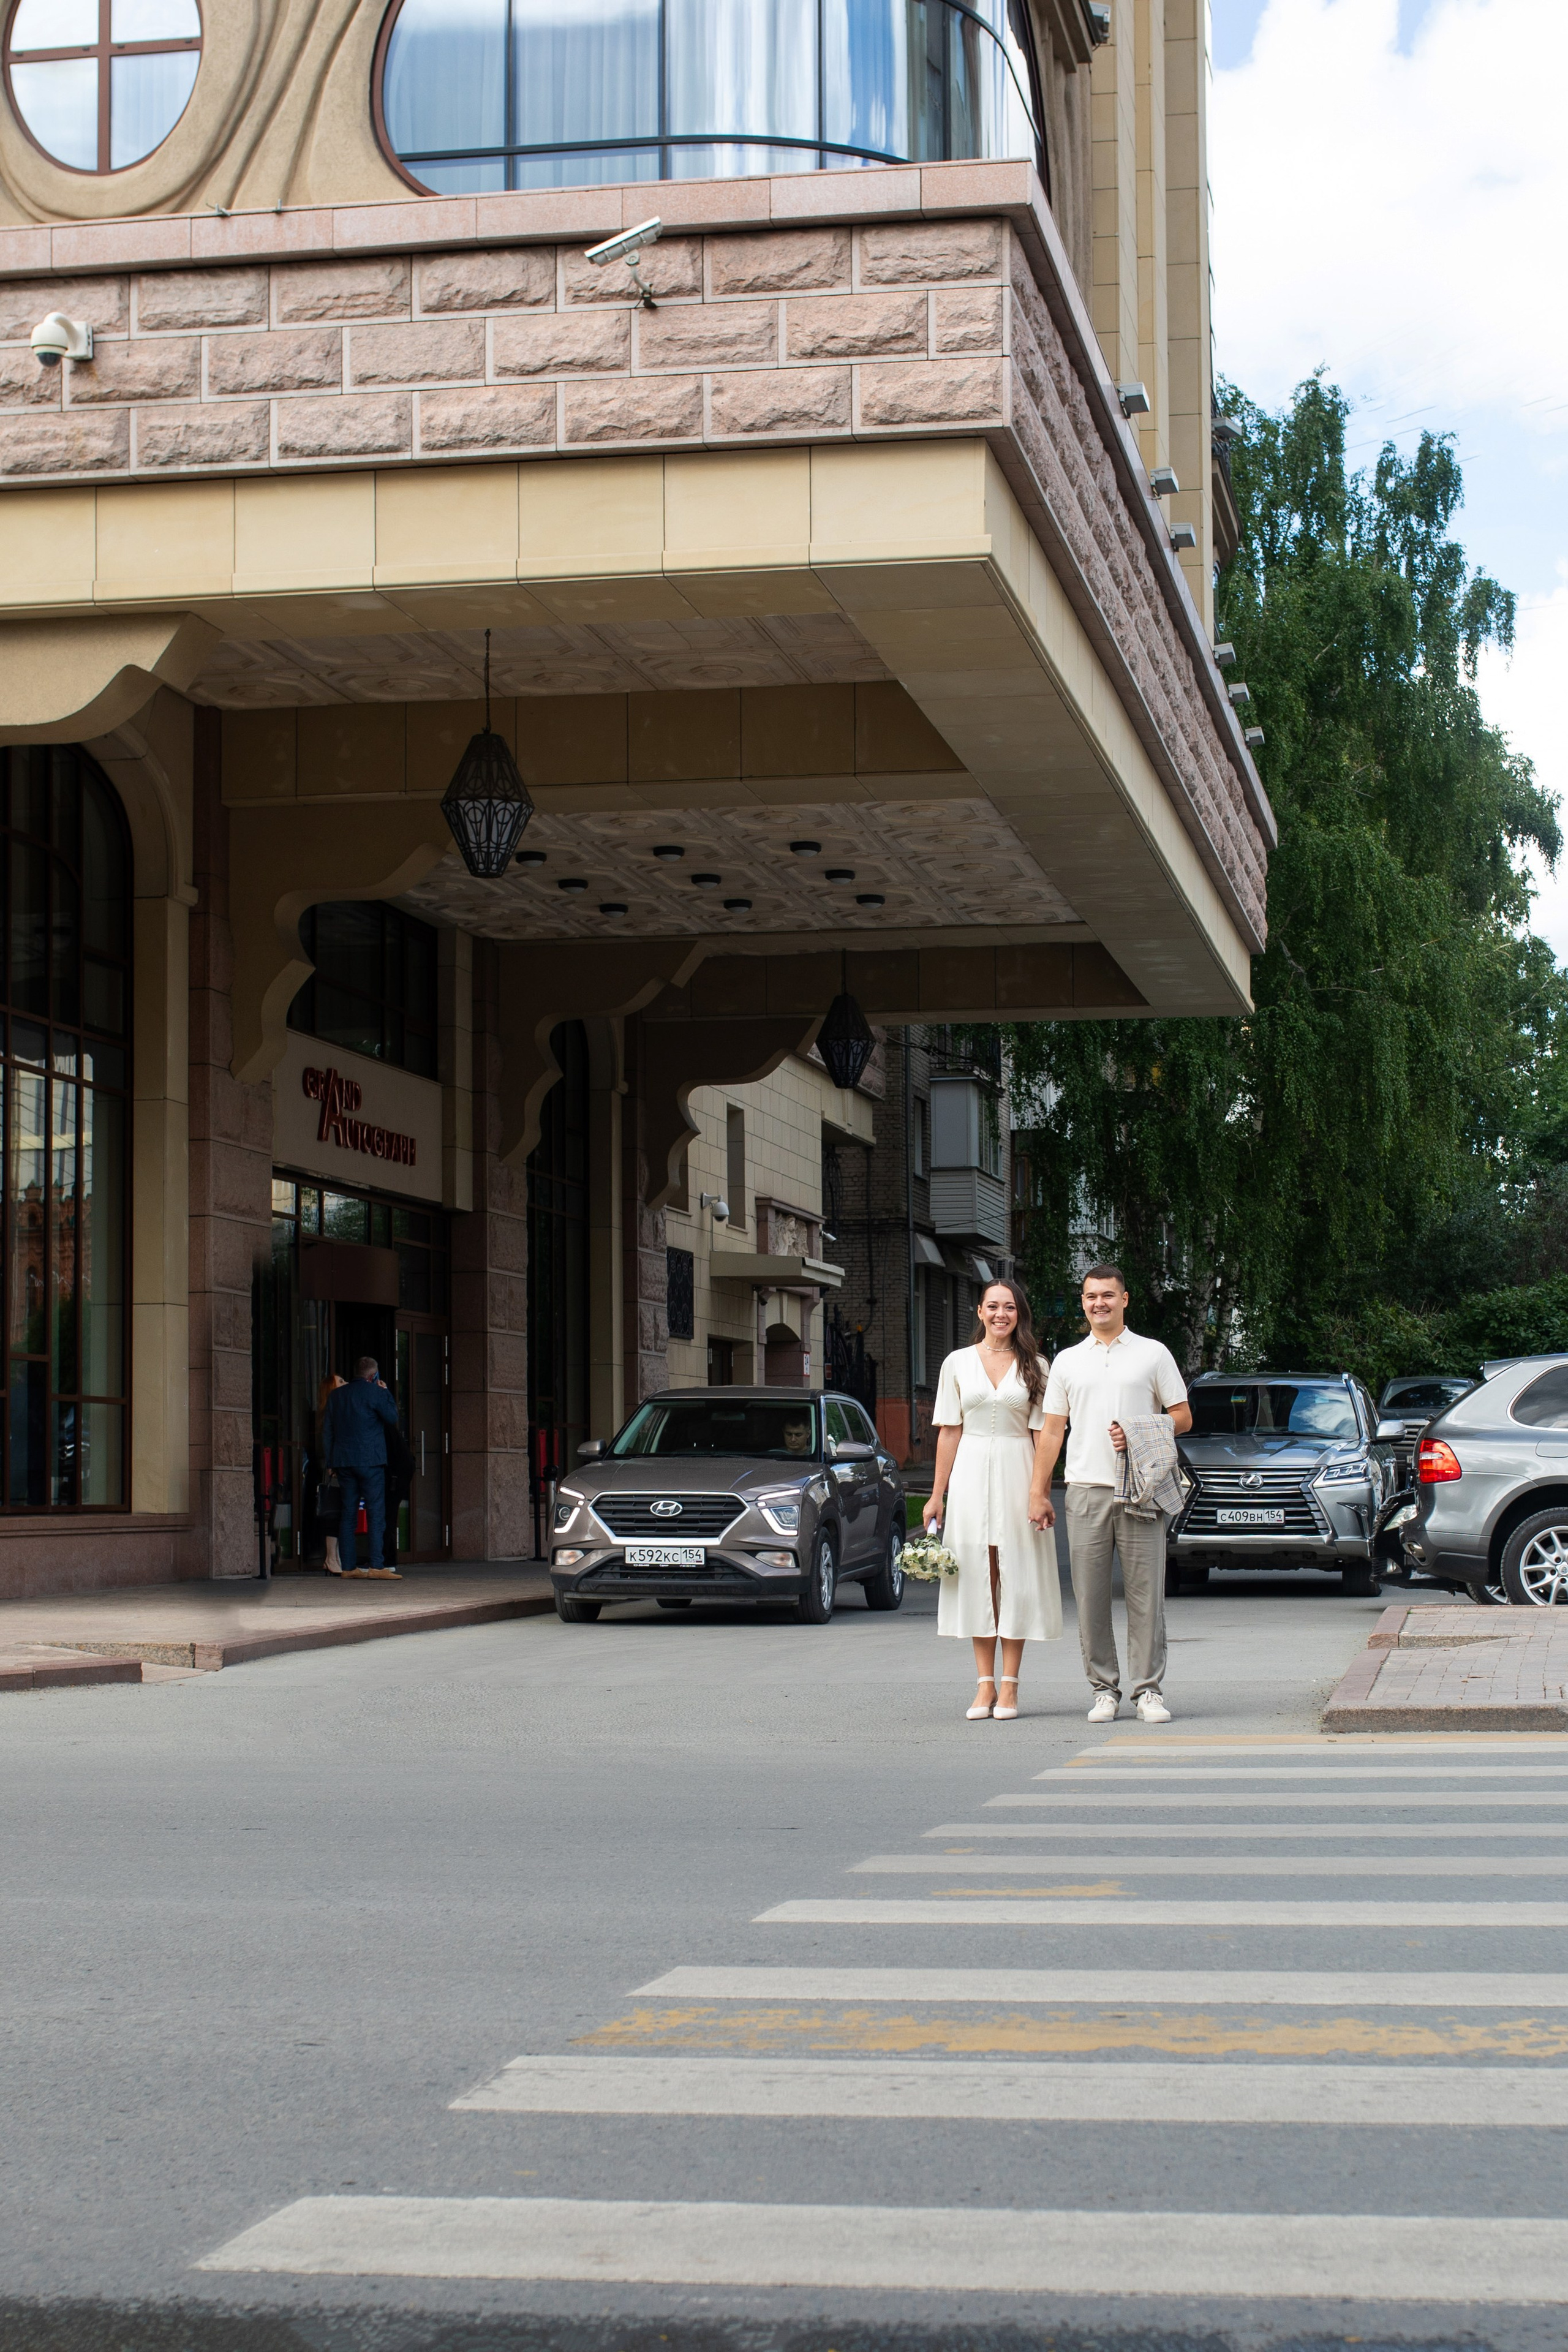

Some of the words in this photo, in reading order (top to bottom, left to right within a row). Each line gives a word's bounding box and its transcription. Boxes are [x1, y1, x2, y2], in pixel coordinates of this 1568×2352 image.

[303, 1067, 362, 1111] GRAND
[317, 1068, 416, 1166] AUTOGRAPH
[682, 1549, 701, 1559] 154
